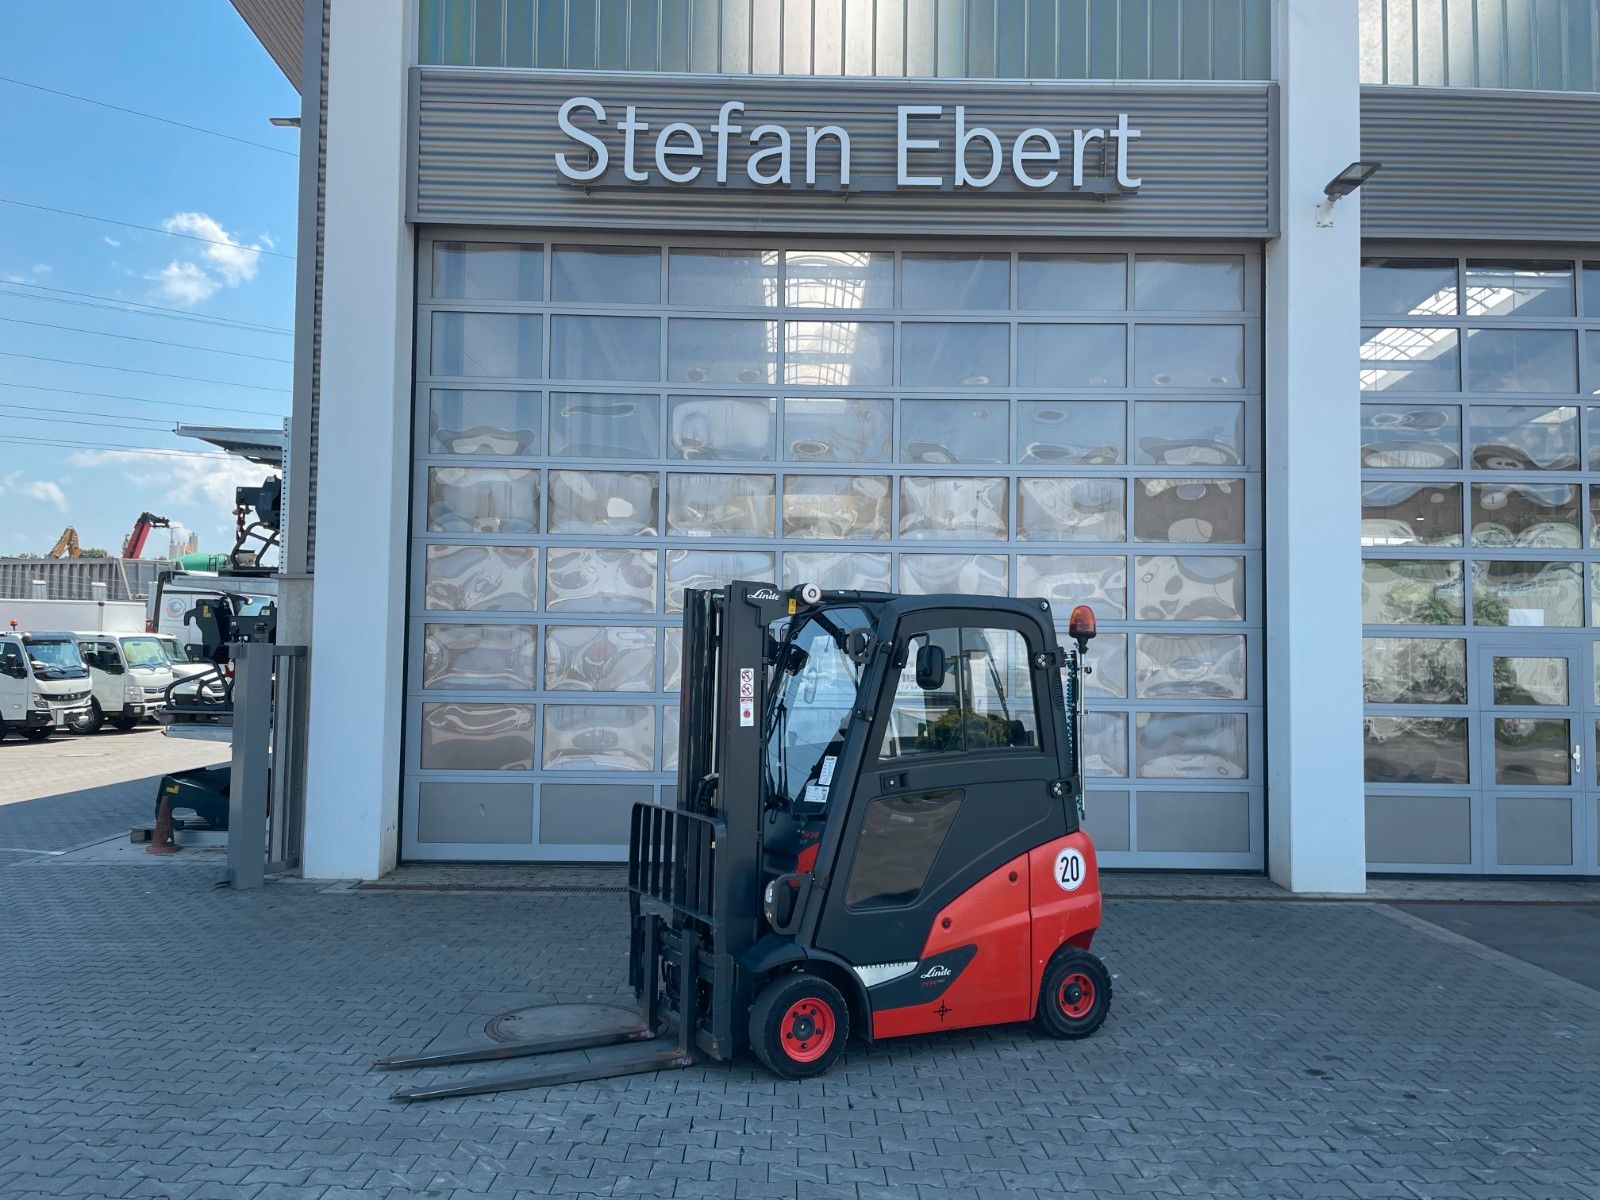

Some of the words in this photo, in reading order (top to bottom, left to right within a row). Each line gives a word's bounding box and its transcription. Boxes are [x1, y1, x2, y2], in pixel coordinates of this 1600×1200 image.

[555, 97, 850, 186] Stefan
[897, 105, 1142, 188] Ebert
[747, 588, 780, 600] Linde
[1060, 856, 1079, 882] 20
[920, 965, 952, 979] Linde
